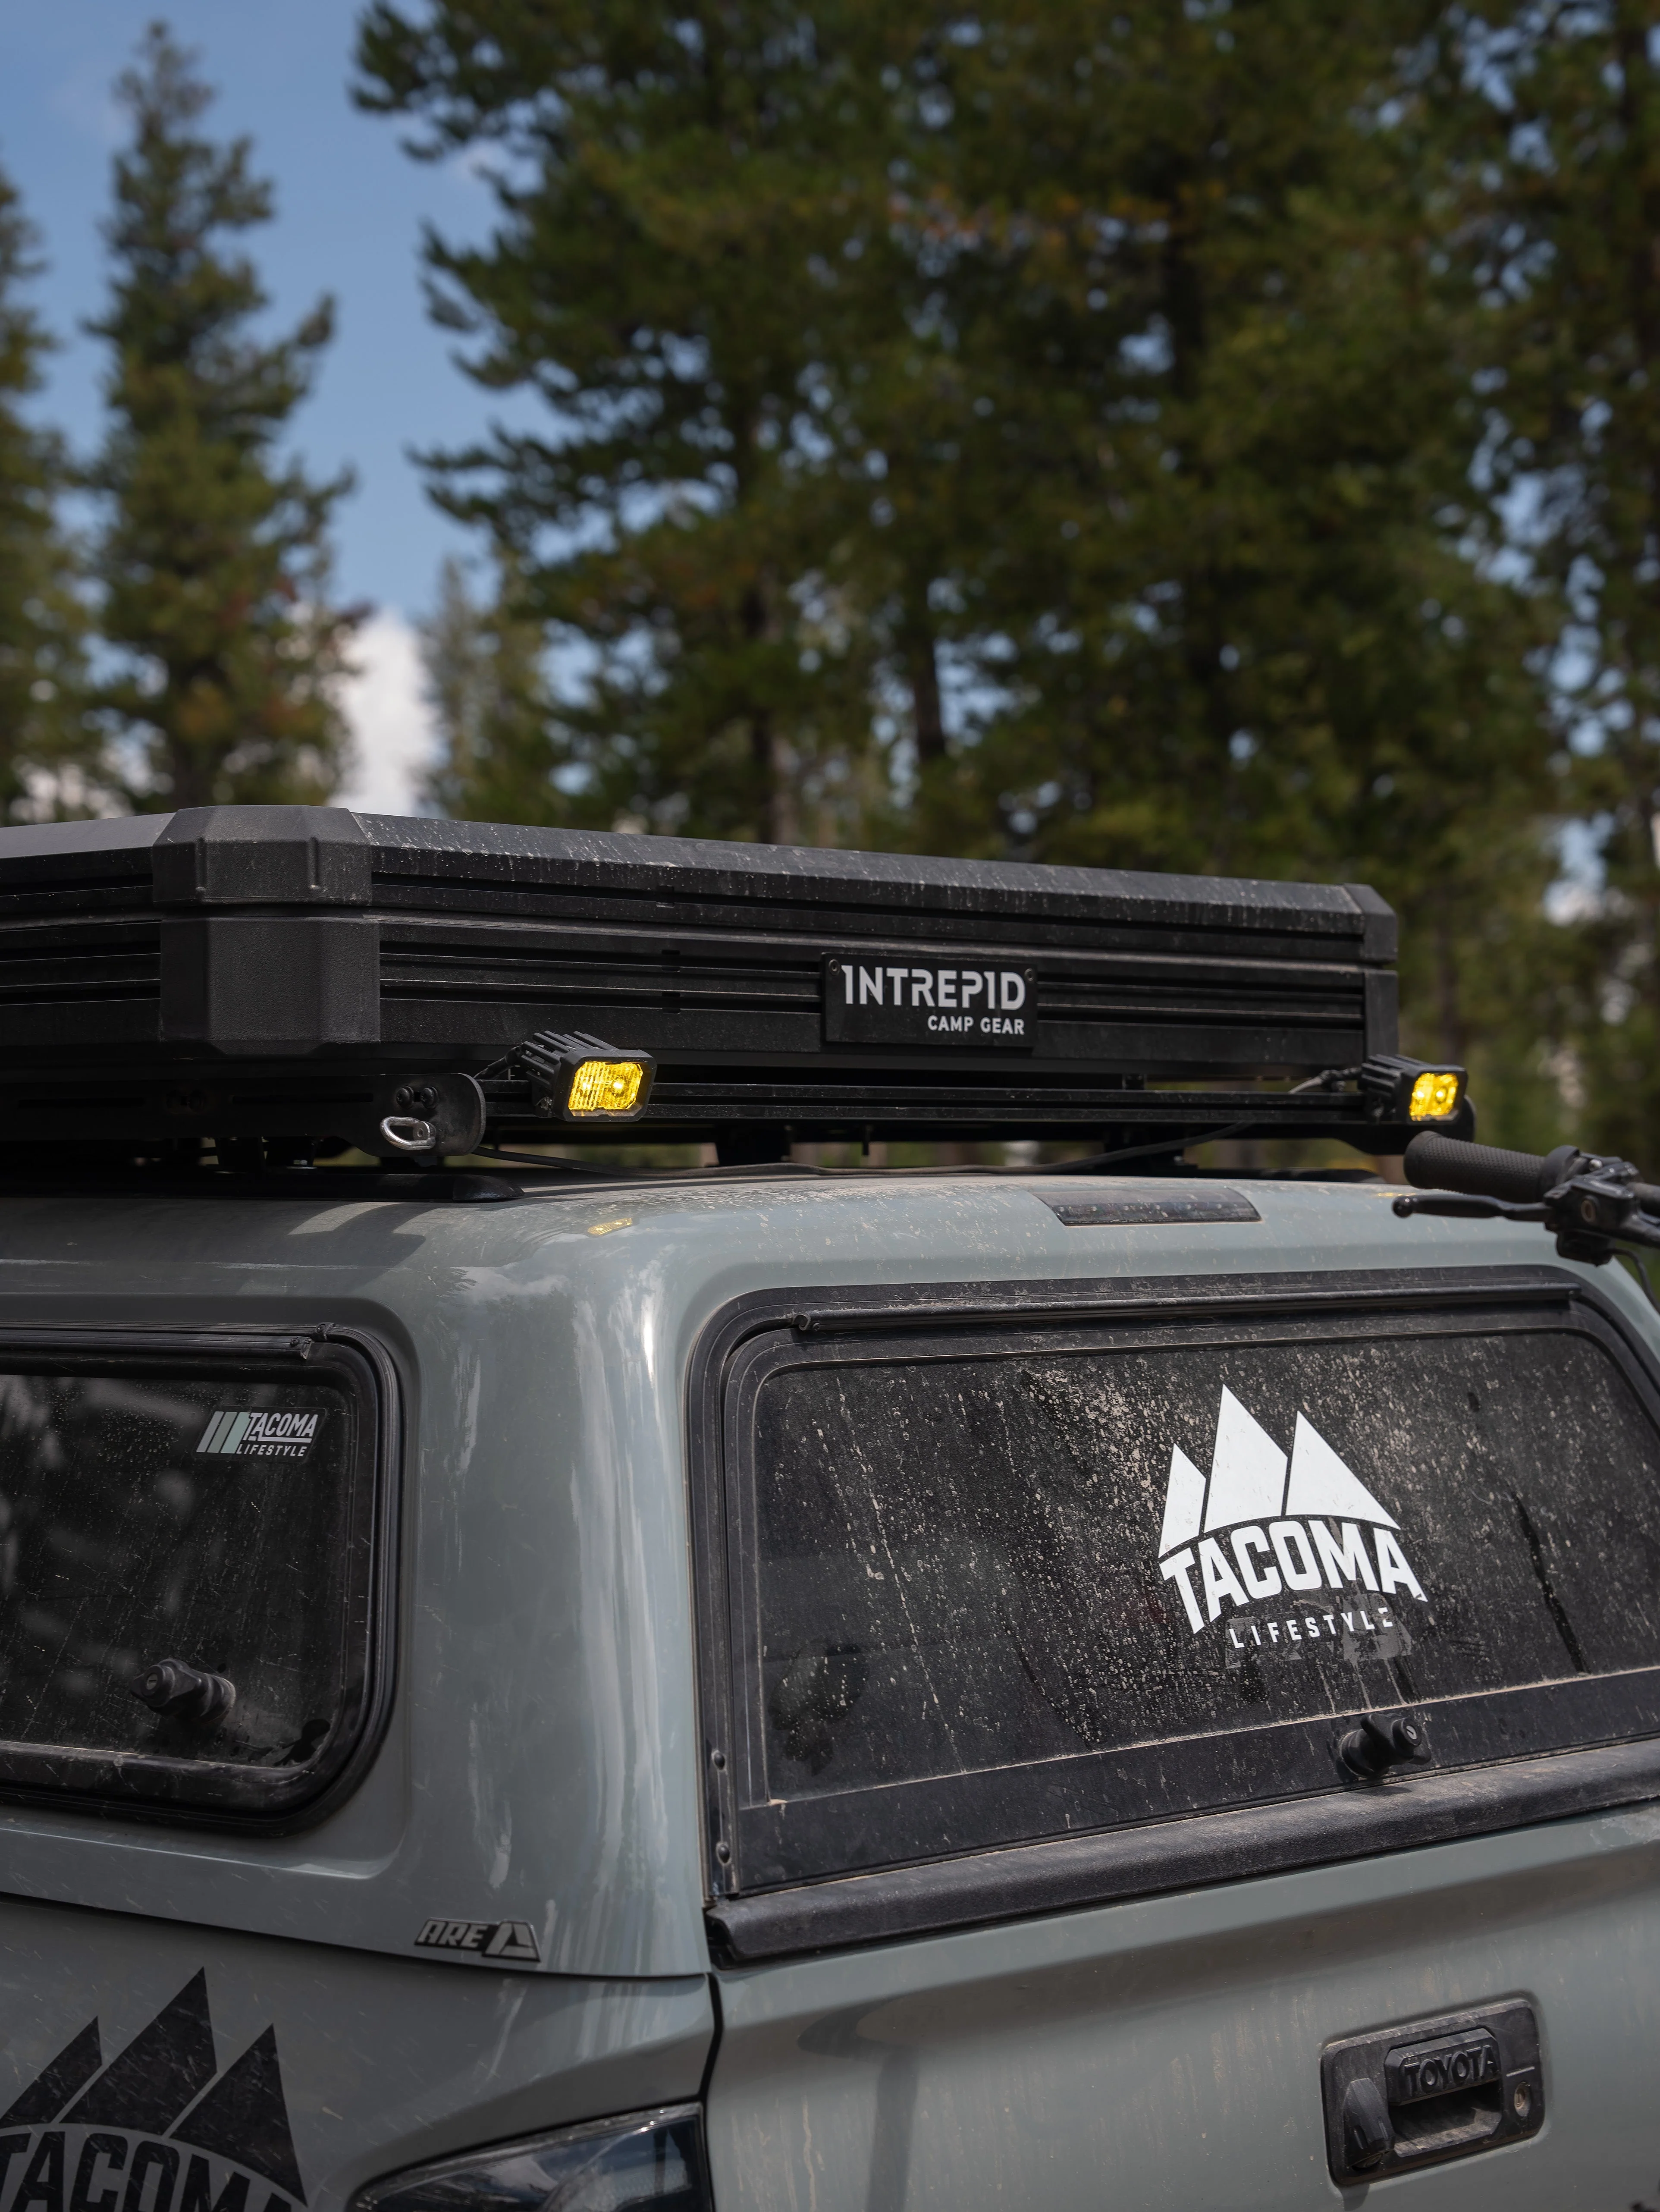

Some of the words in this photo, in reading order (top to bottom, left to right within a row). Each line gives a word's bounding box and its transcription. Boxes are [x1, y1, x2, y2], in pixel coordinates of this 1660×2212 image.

[841, 965, 1025, 1010] INTREPID
[927, 1015, 973, 1032] CAMP
[980, 1017, 1024, 1035] GEAR
[242, 1412, 318, 1443] TACOMA
[236, 1444, 308, 1457] LIFESTYLE
[1159, 1520, 1428, 1634] TACOMA
[1403, 2044, 1499, 2097] TOYOTA
[0, 2131, 291, 2212] ACOM
